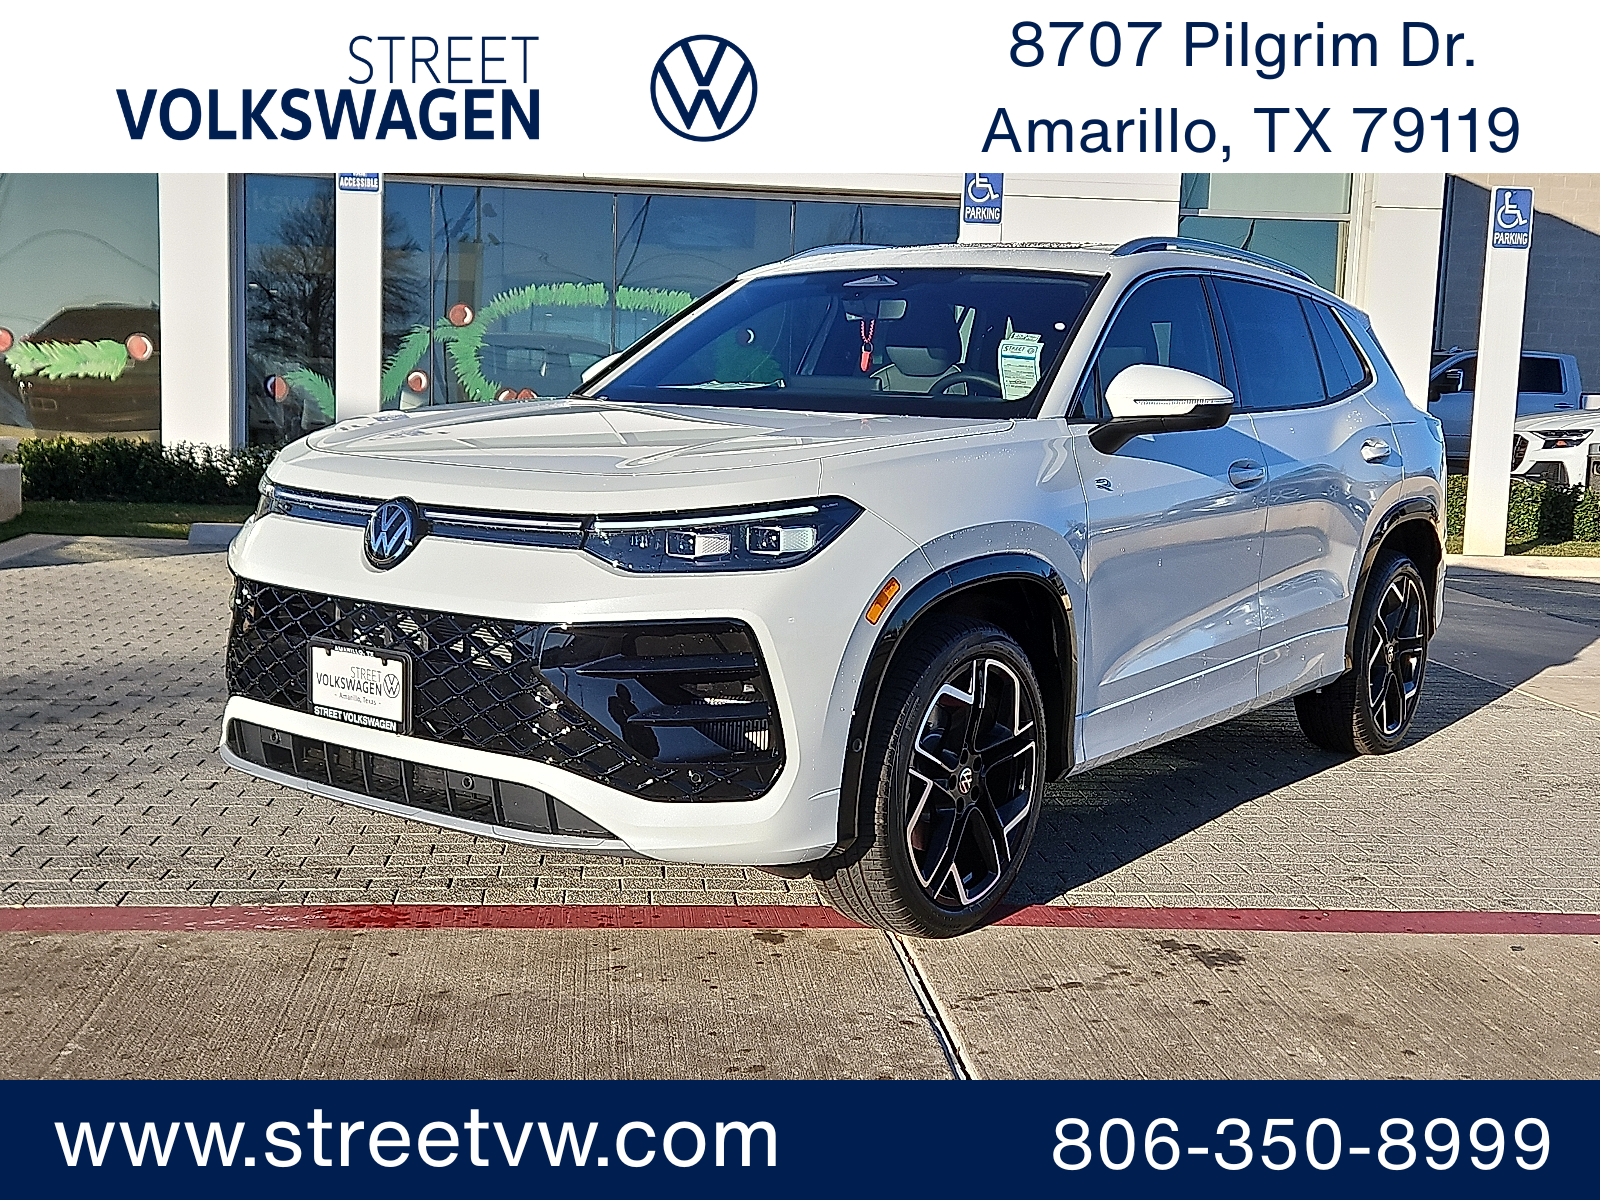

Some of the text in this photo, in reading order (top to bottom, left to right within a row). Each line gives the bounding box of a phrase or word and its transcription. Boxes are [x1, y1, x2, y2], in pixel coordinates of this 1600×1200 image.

[340, 176, 379, 188] ACCESSIBLE
[965, 206, 1000, 220] PARKING
[1493, 232, 1528, 245] PARKING
[350, 666, 382, 683] STREET
[316, 672, 382, 697] VOLKSWAGEN
[339, 692, 377, 706] Amarillo, Texas
[313, 705, 397, 732] STREET VOLKSWAGEN
